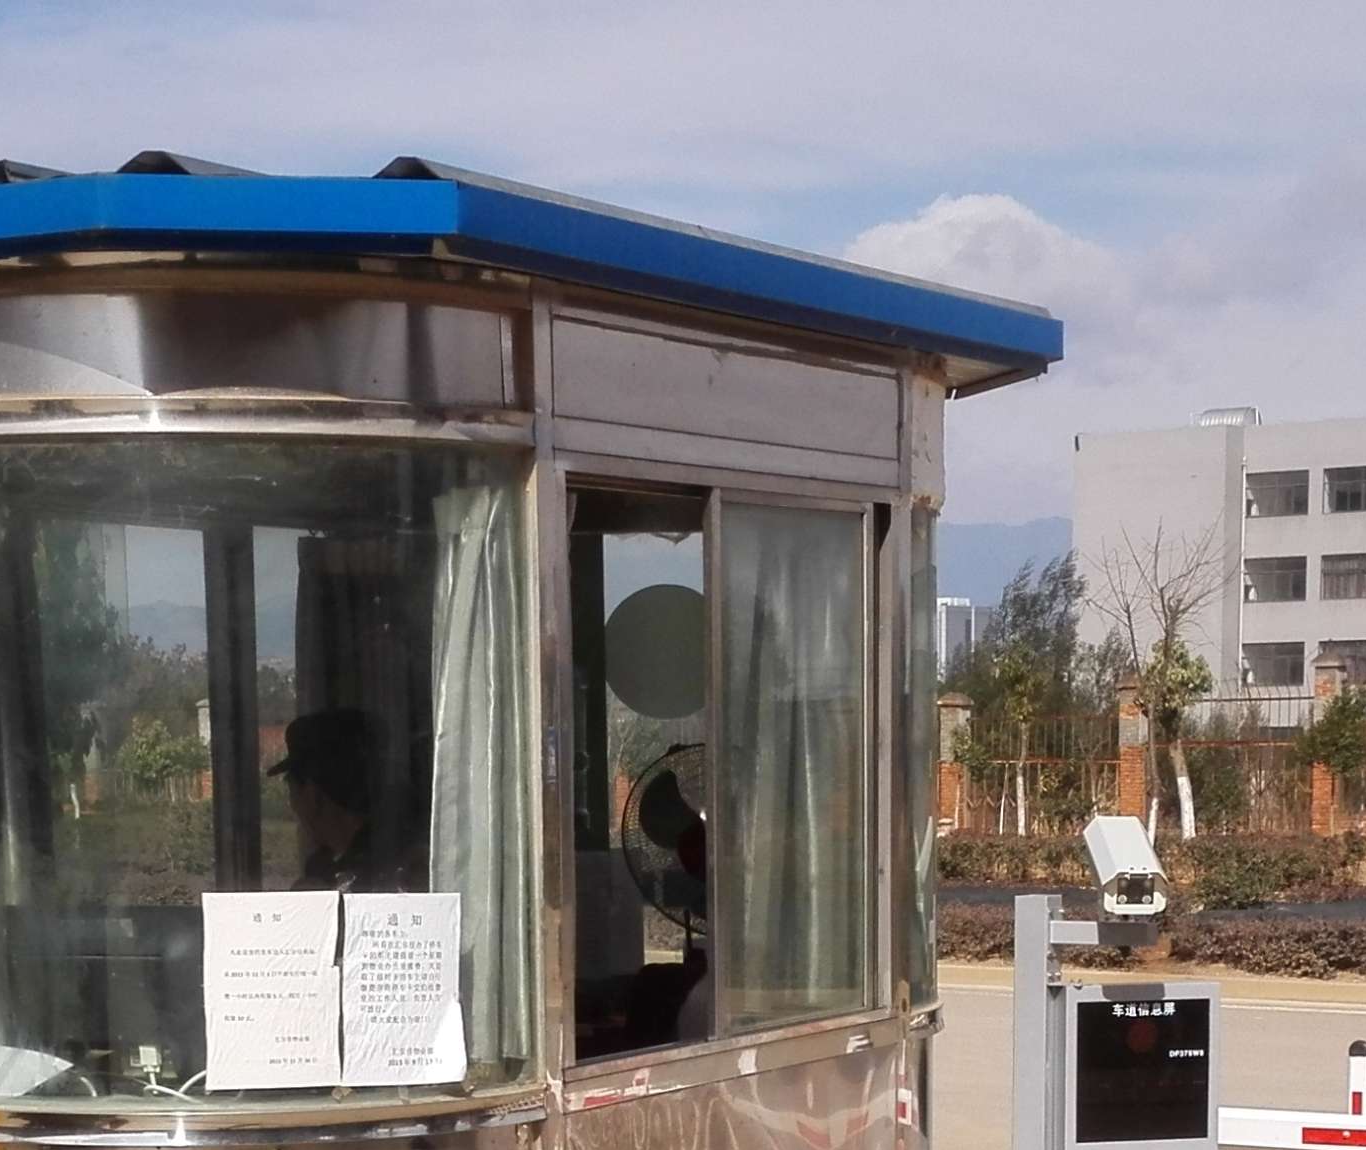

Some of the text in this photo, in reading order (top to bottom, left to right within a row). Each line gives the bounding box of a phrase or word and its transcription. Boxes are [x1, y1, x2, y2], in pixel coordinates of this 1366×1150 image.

[387, 912, 423, 927] 通知
[1112, 1002, 1176, 1017] 车道信息屏
